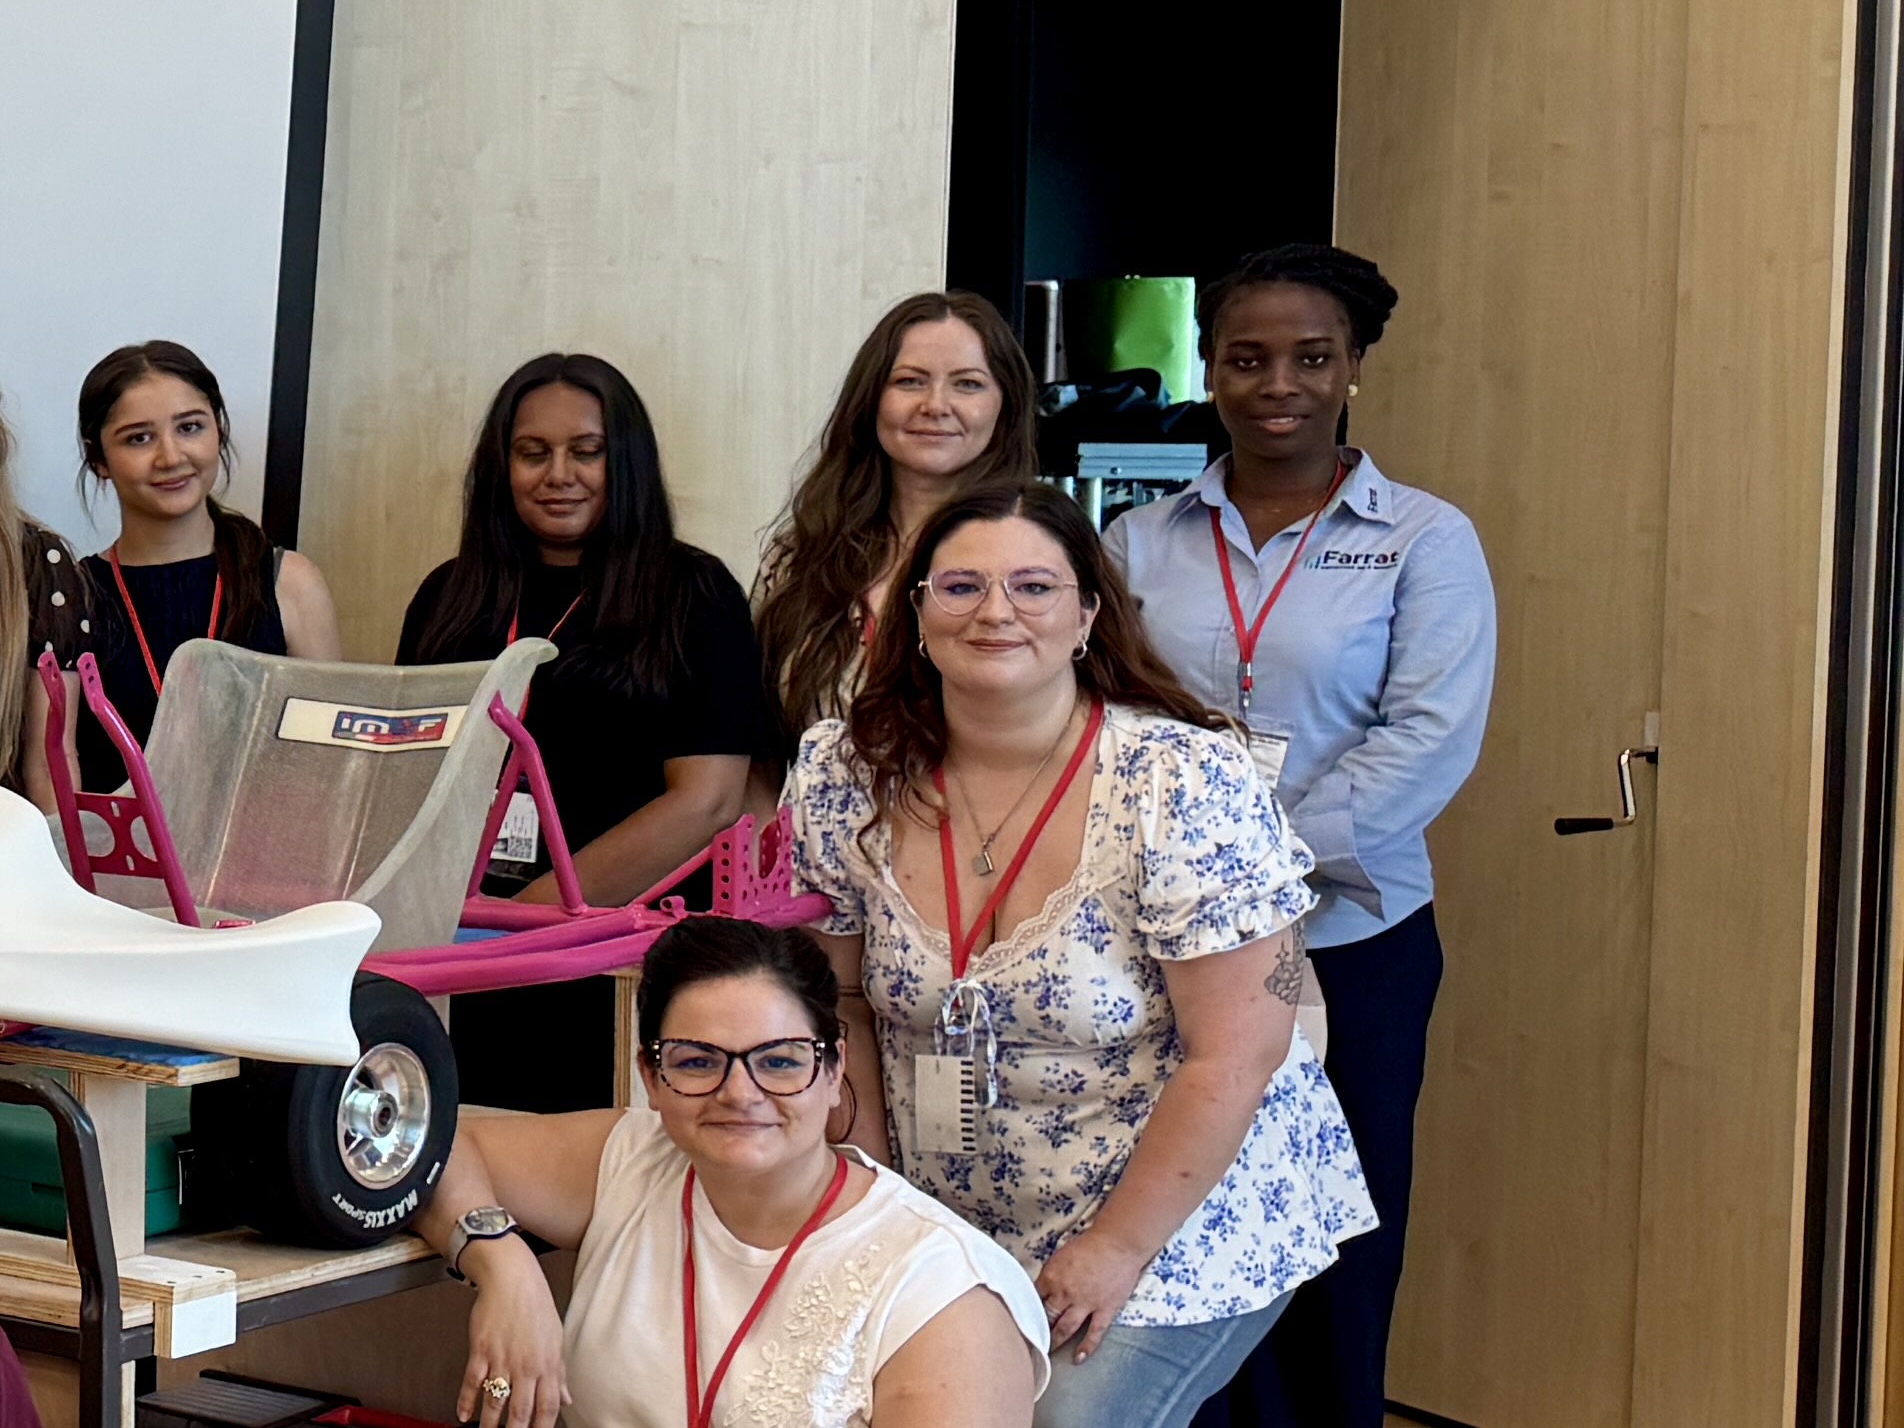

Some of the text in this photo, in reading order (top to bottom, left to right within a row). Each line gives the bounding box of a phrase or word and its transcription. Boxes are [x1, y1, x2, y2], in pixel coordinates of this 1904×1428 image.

[1323, 550, 1399, 565] Farrat
[331, 1193, 366, 1221] SPORT
[363, 1188, 419, 1229] MAXXIS
